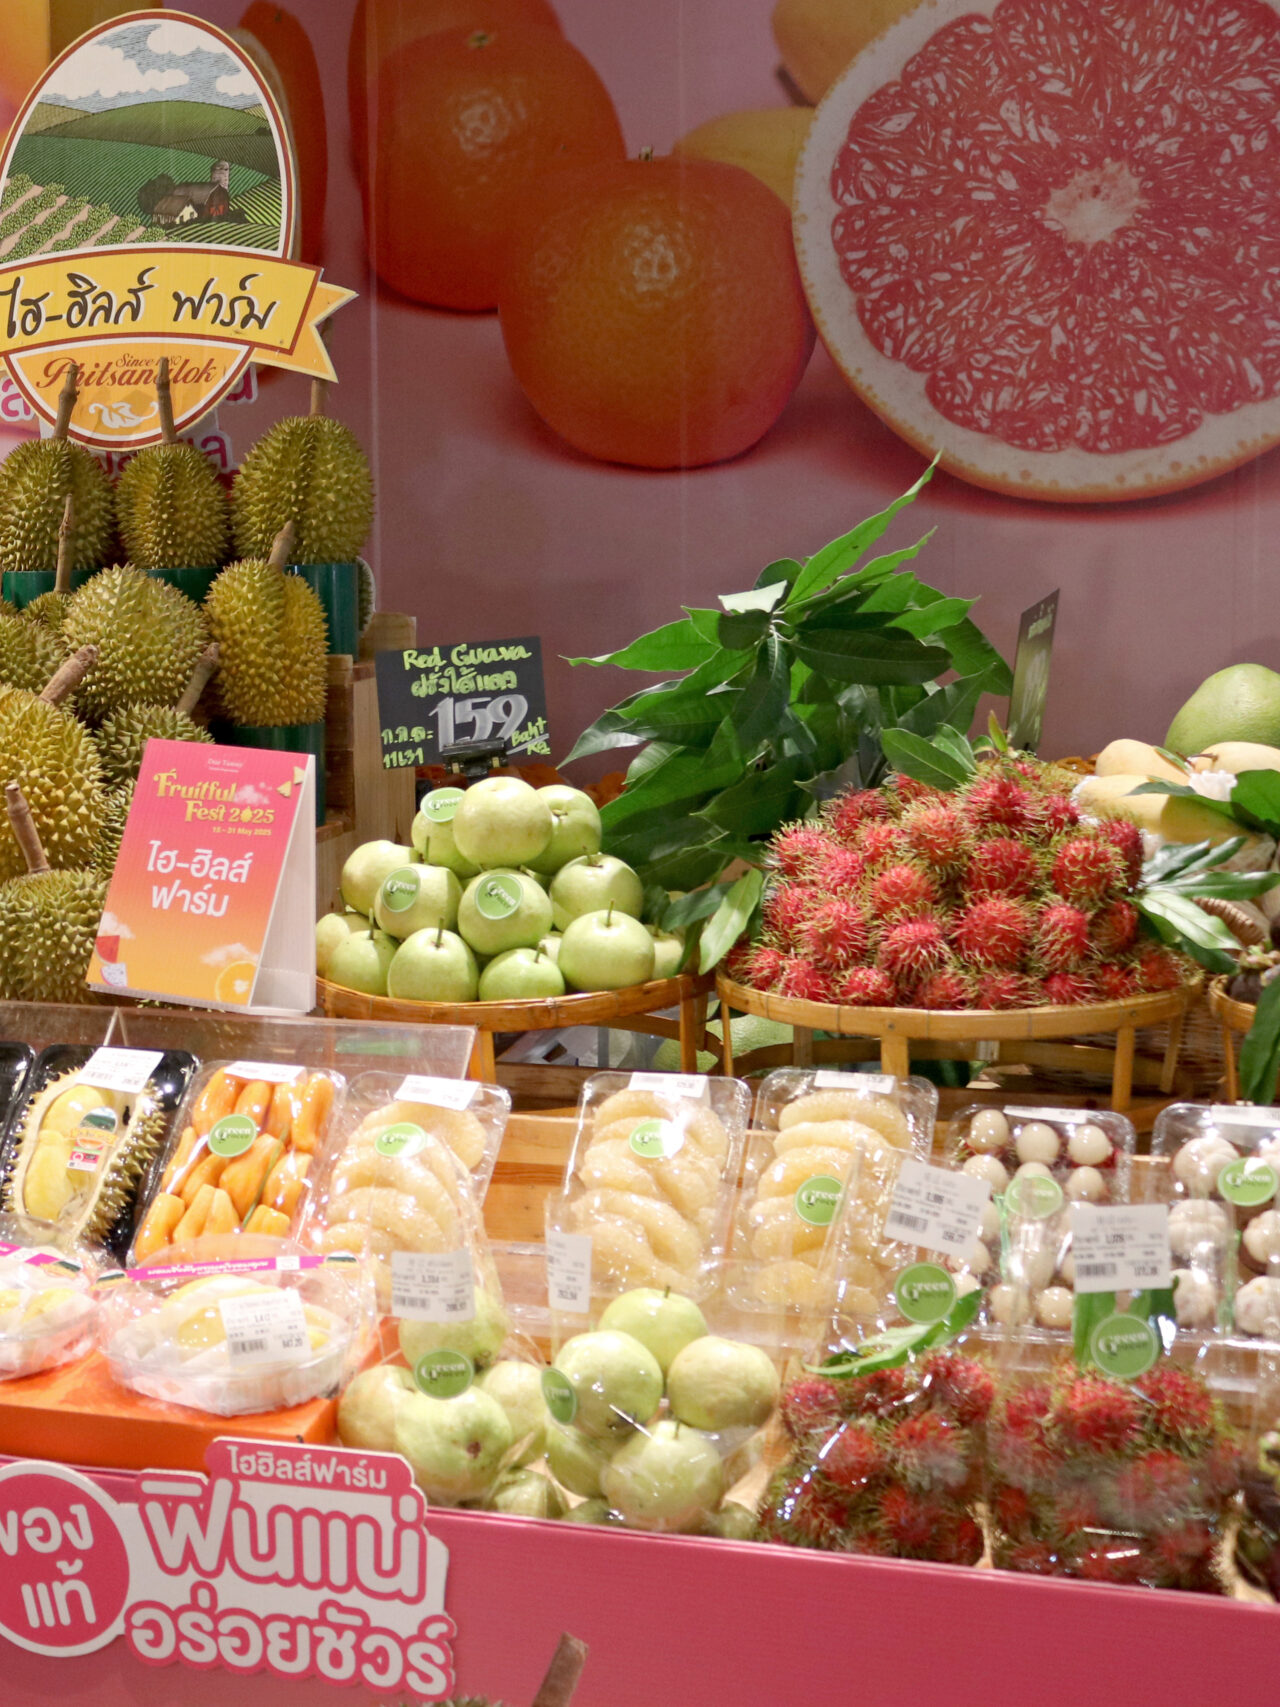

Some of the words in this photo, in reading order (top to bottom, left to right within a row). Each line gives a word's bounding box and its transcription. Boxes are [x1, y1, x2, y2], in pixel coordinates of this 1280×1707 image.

[172, 273, 277, 330] ฟาร์ม
[116, 353, 154, 367] Since
[403, 647, 447, 670] Red
[451, 644, 532, 666] Guava
[428, 694, 528, 752] 159
[154, 769, 237, 803] Fruitful
[184, 799, 226, 823] Fest
[147, 840, 254, 884] ไฮ-ฮิลส์
[151, 879, 229, 918] ฟาร์ม
[227, 1446, 387, 1490] ไฮฮิลส์ฟาร์ม
[140, 1478, 420, 1597] ฟินแน่
[21, 1559, 97, 1628] แท้
[131, 1587, 449, 1697] อร่อยชัวร์
